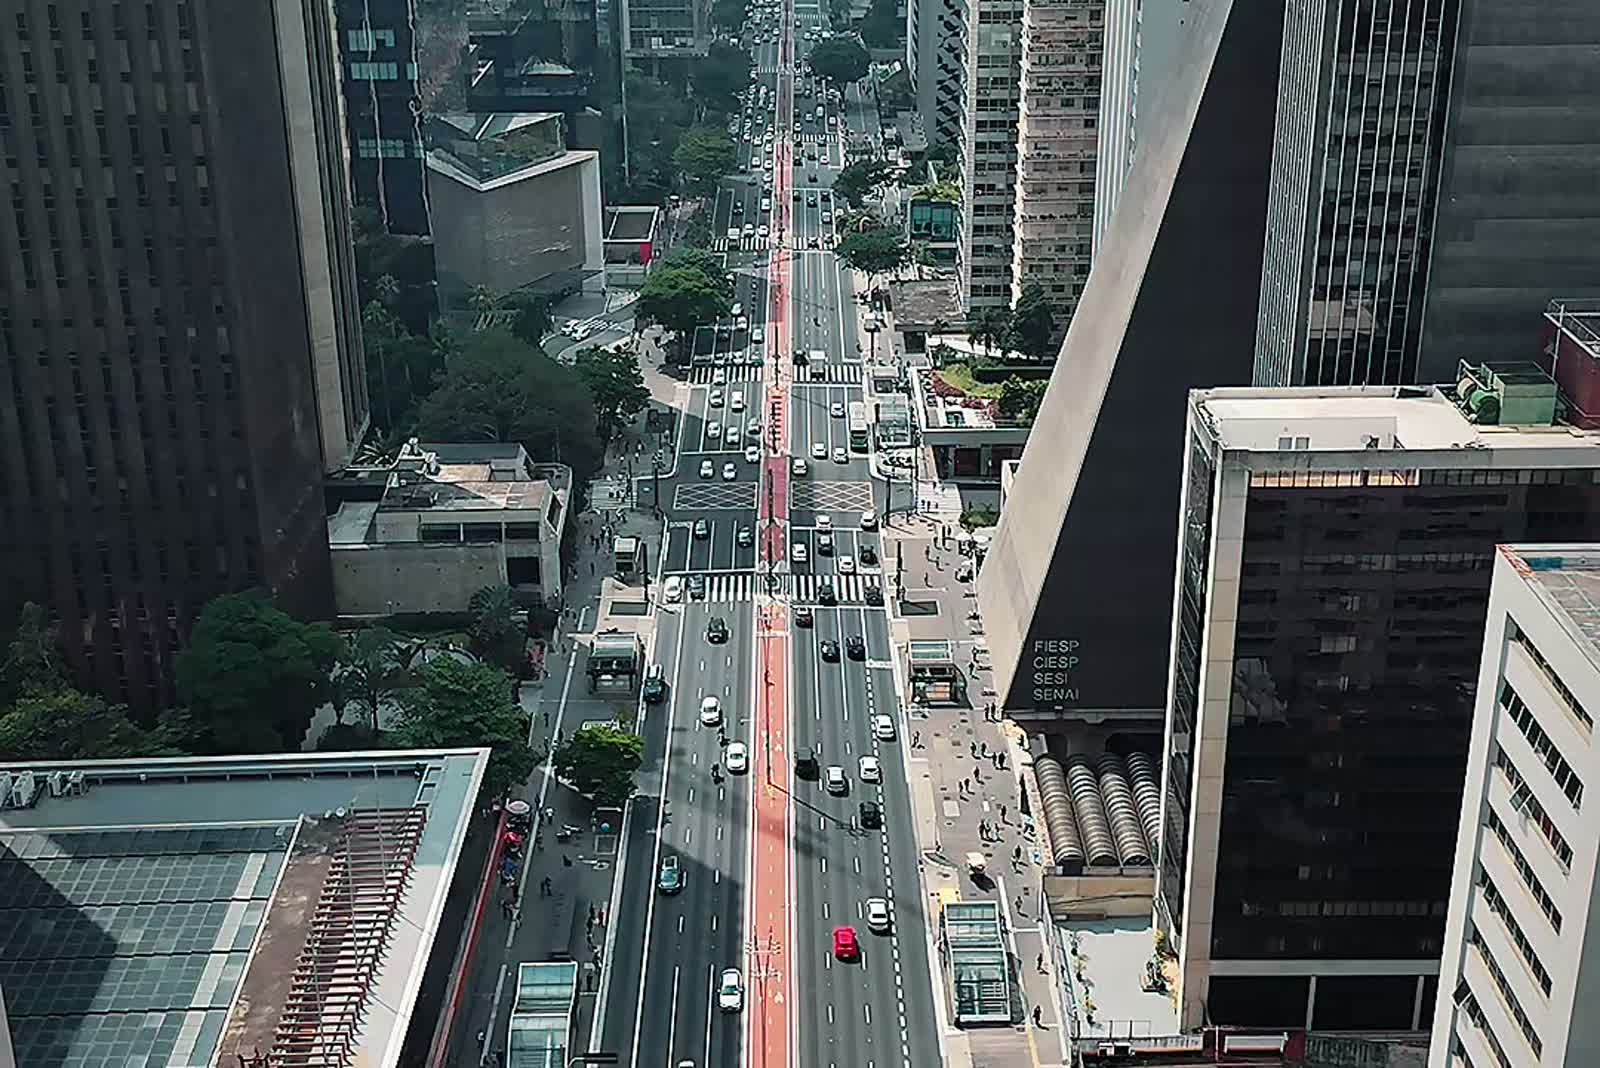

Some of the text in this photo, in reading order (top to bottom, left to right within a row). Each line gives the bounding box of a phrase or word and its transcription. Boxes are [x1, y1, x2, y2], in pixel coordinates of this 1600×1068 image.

[1034, 640, 1080, 653] FIESP
[1033, 656, 1079, 669] CIESP
[1033, 672, 1068, 685] SESI
[1033, 688, 1080, 701] SENAI
